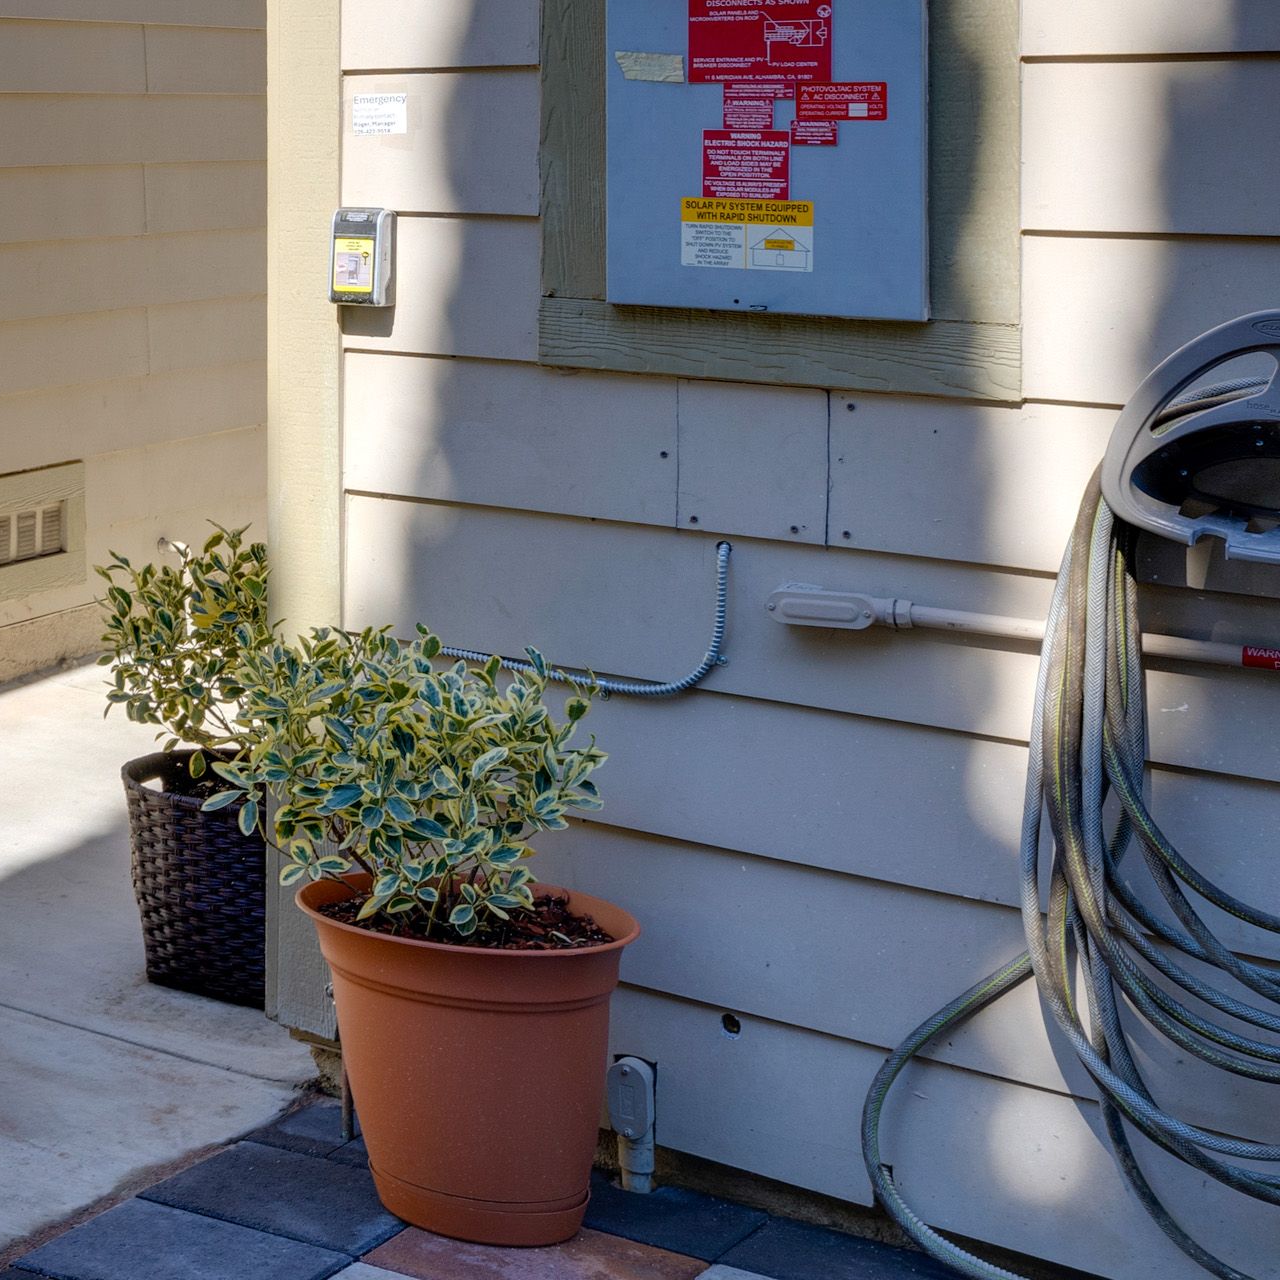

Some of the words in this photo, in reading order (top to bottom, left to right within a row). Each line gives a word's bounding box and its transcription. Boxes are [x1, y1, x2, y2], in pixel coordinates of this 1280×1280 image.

[706, 0, 762, 7] DISCONNECTS
[353, 95, 407, 105] Emergency
[686, 201, 713, 210] SOLAR
[716, 202, 727, 210] PV
[729, 202, 763, 212] SYSTEM
[765, 203, 809, 213] EQUIPPED
[697, 211, 717, 220] WITH
[720, 212, 745, 221] RAPID
[748, 213, 797, 223] SHUTDOWN
